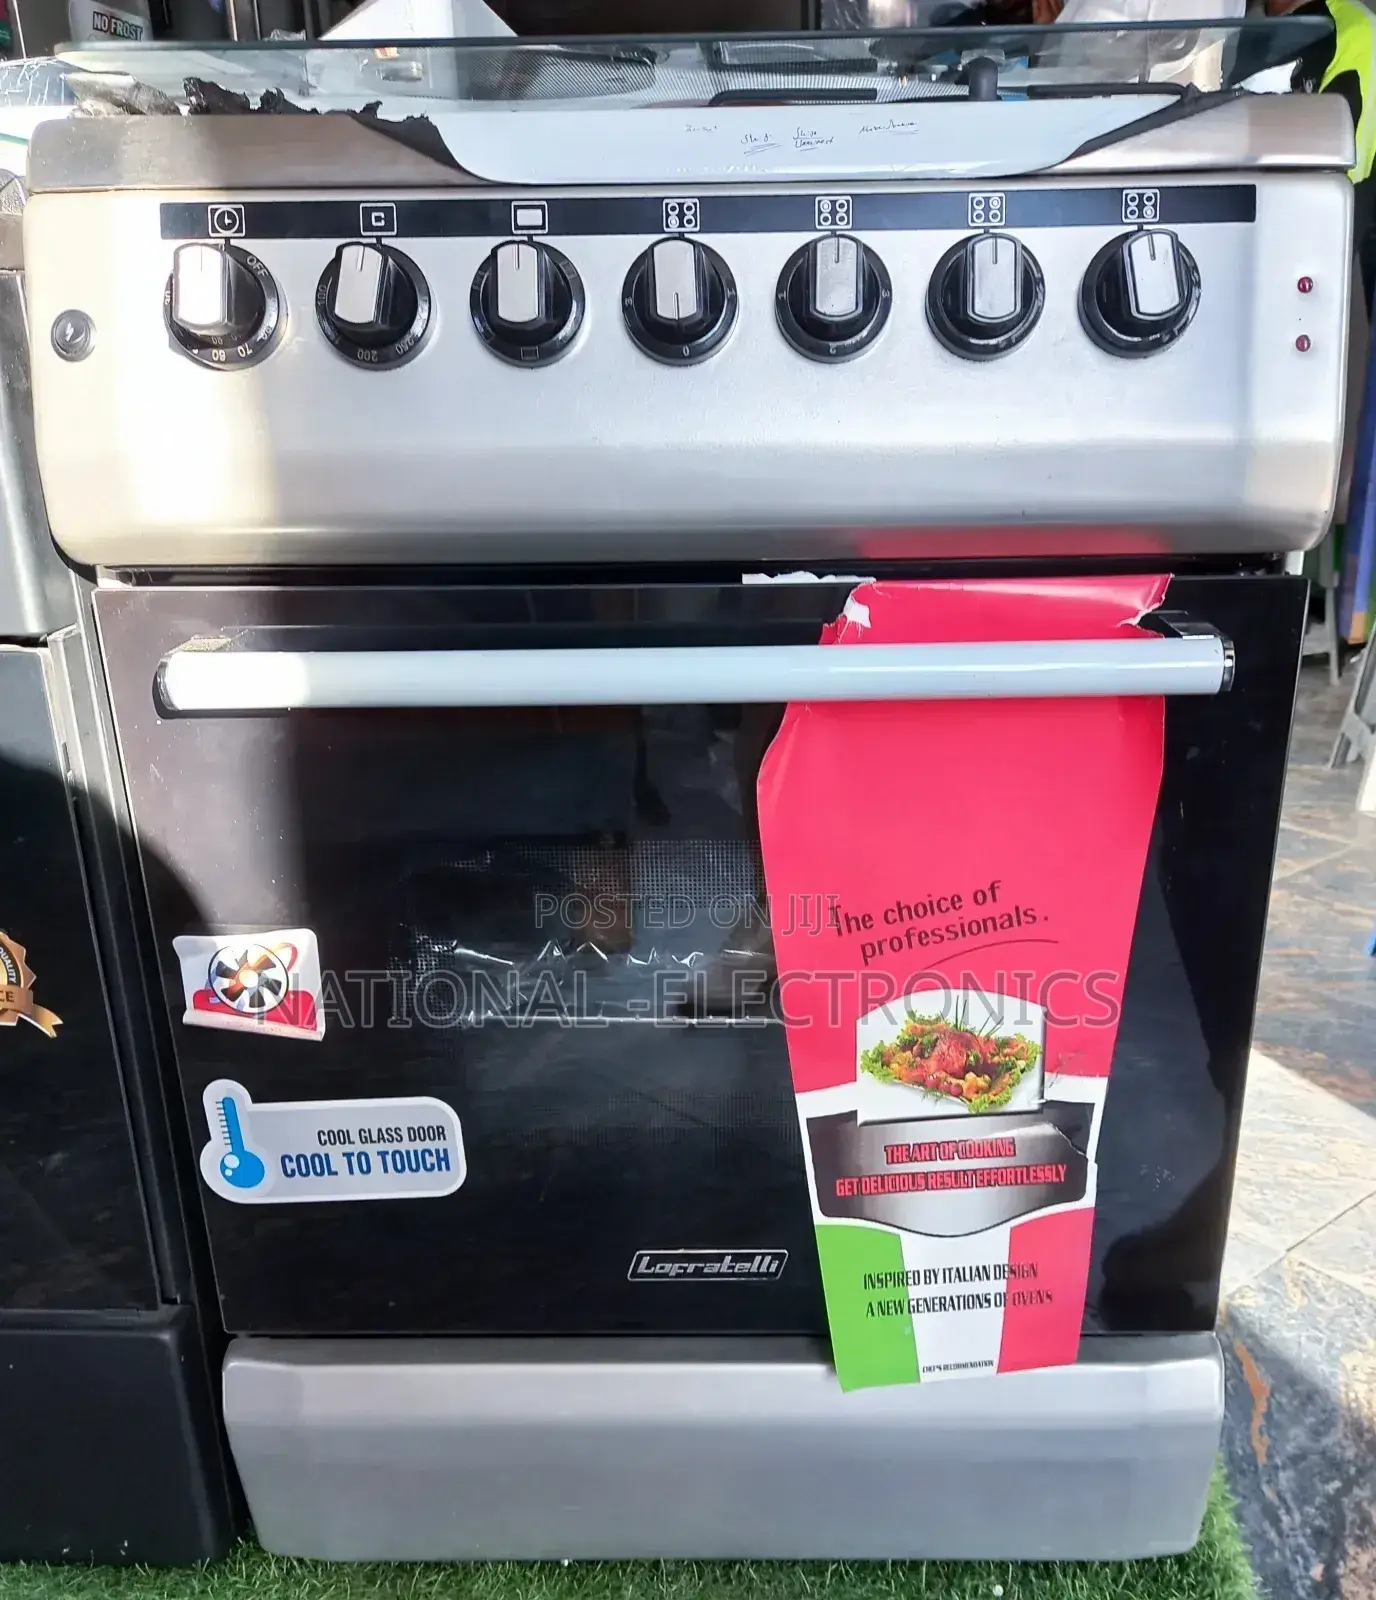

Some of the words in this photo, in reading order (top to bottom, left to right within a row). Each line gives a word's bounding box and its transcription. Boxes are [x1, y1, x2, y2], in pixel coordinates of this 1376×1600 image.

[93, 11, 109, 33] NO
[110, 16, 143, 42] FROST
[246, 256, 268, 277] OFF
[212, 349, 226, 362] 60
[237, 343, 253, 357] 70
[357, 349, 378, 362] 200
[828, 904, 874, 937] The
[883, 892, 963, 926] choice
[972, 880, 1002, 906] of
[317, 1127, 355, 1147] COOL
[359, 1125, 404, 1145] GLASS
[407, 1124, 447, 1144] DOOR
[280, 1153, 339, 1179] COOL
[342, 1151, 372, 1176] TO
[376, 1147, 452, 1174] TOUCH
[884, 1144, 910, 1165] THE
[911, 1142, 940, 1162] ART
[940, 1140, 958, 1160] OF
[958, 1136, 1016, 1160] COOKING
[836, 1177, 860, 1197] GET
[861, 1172, 926, 1196] DELICIOUS
[926, 1167, 975, 1190] RESULT
[975, 1163, 1067, 1188] EFFORTLESSLY
[636, 1255, 780, 1277] Lofratelli
[863, 1269, 921, 1290] INSPIRED
[923, 1267, 940, 1286] BY
[942, 1264, 991, 1285] ITALIAN
[993, 1261, 1038, 1281] DESIGN
[866, 1300, 875, 1319] A
[877, 1299, 905, 1318] NEW
[907, 1292, 992, 1315] GENERATIONS
[994, 1291, 1009, 1308] OF
[1012, 1288, 1054, 1307] OVENS
